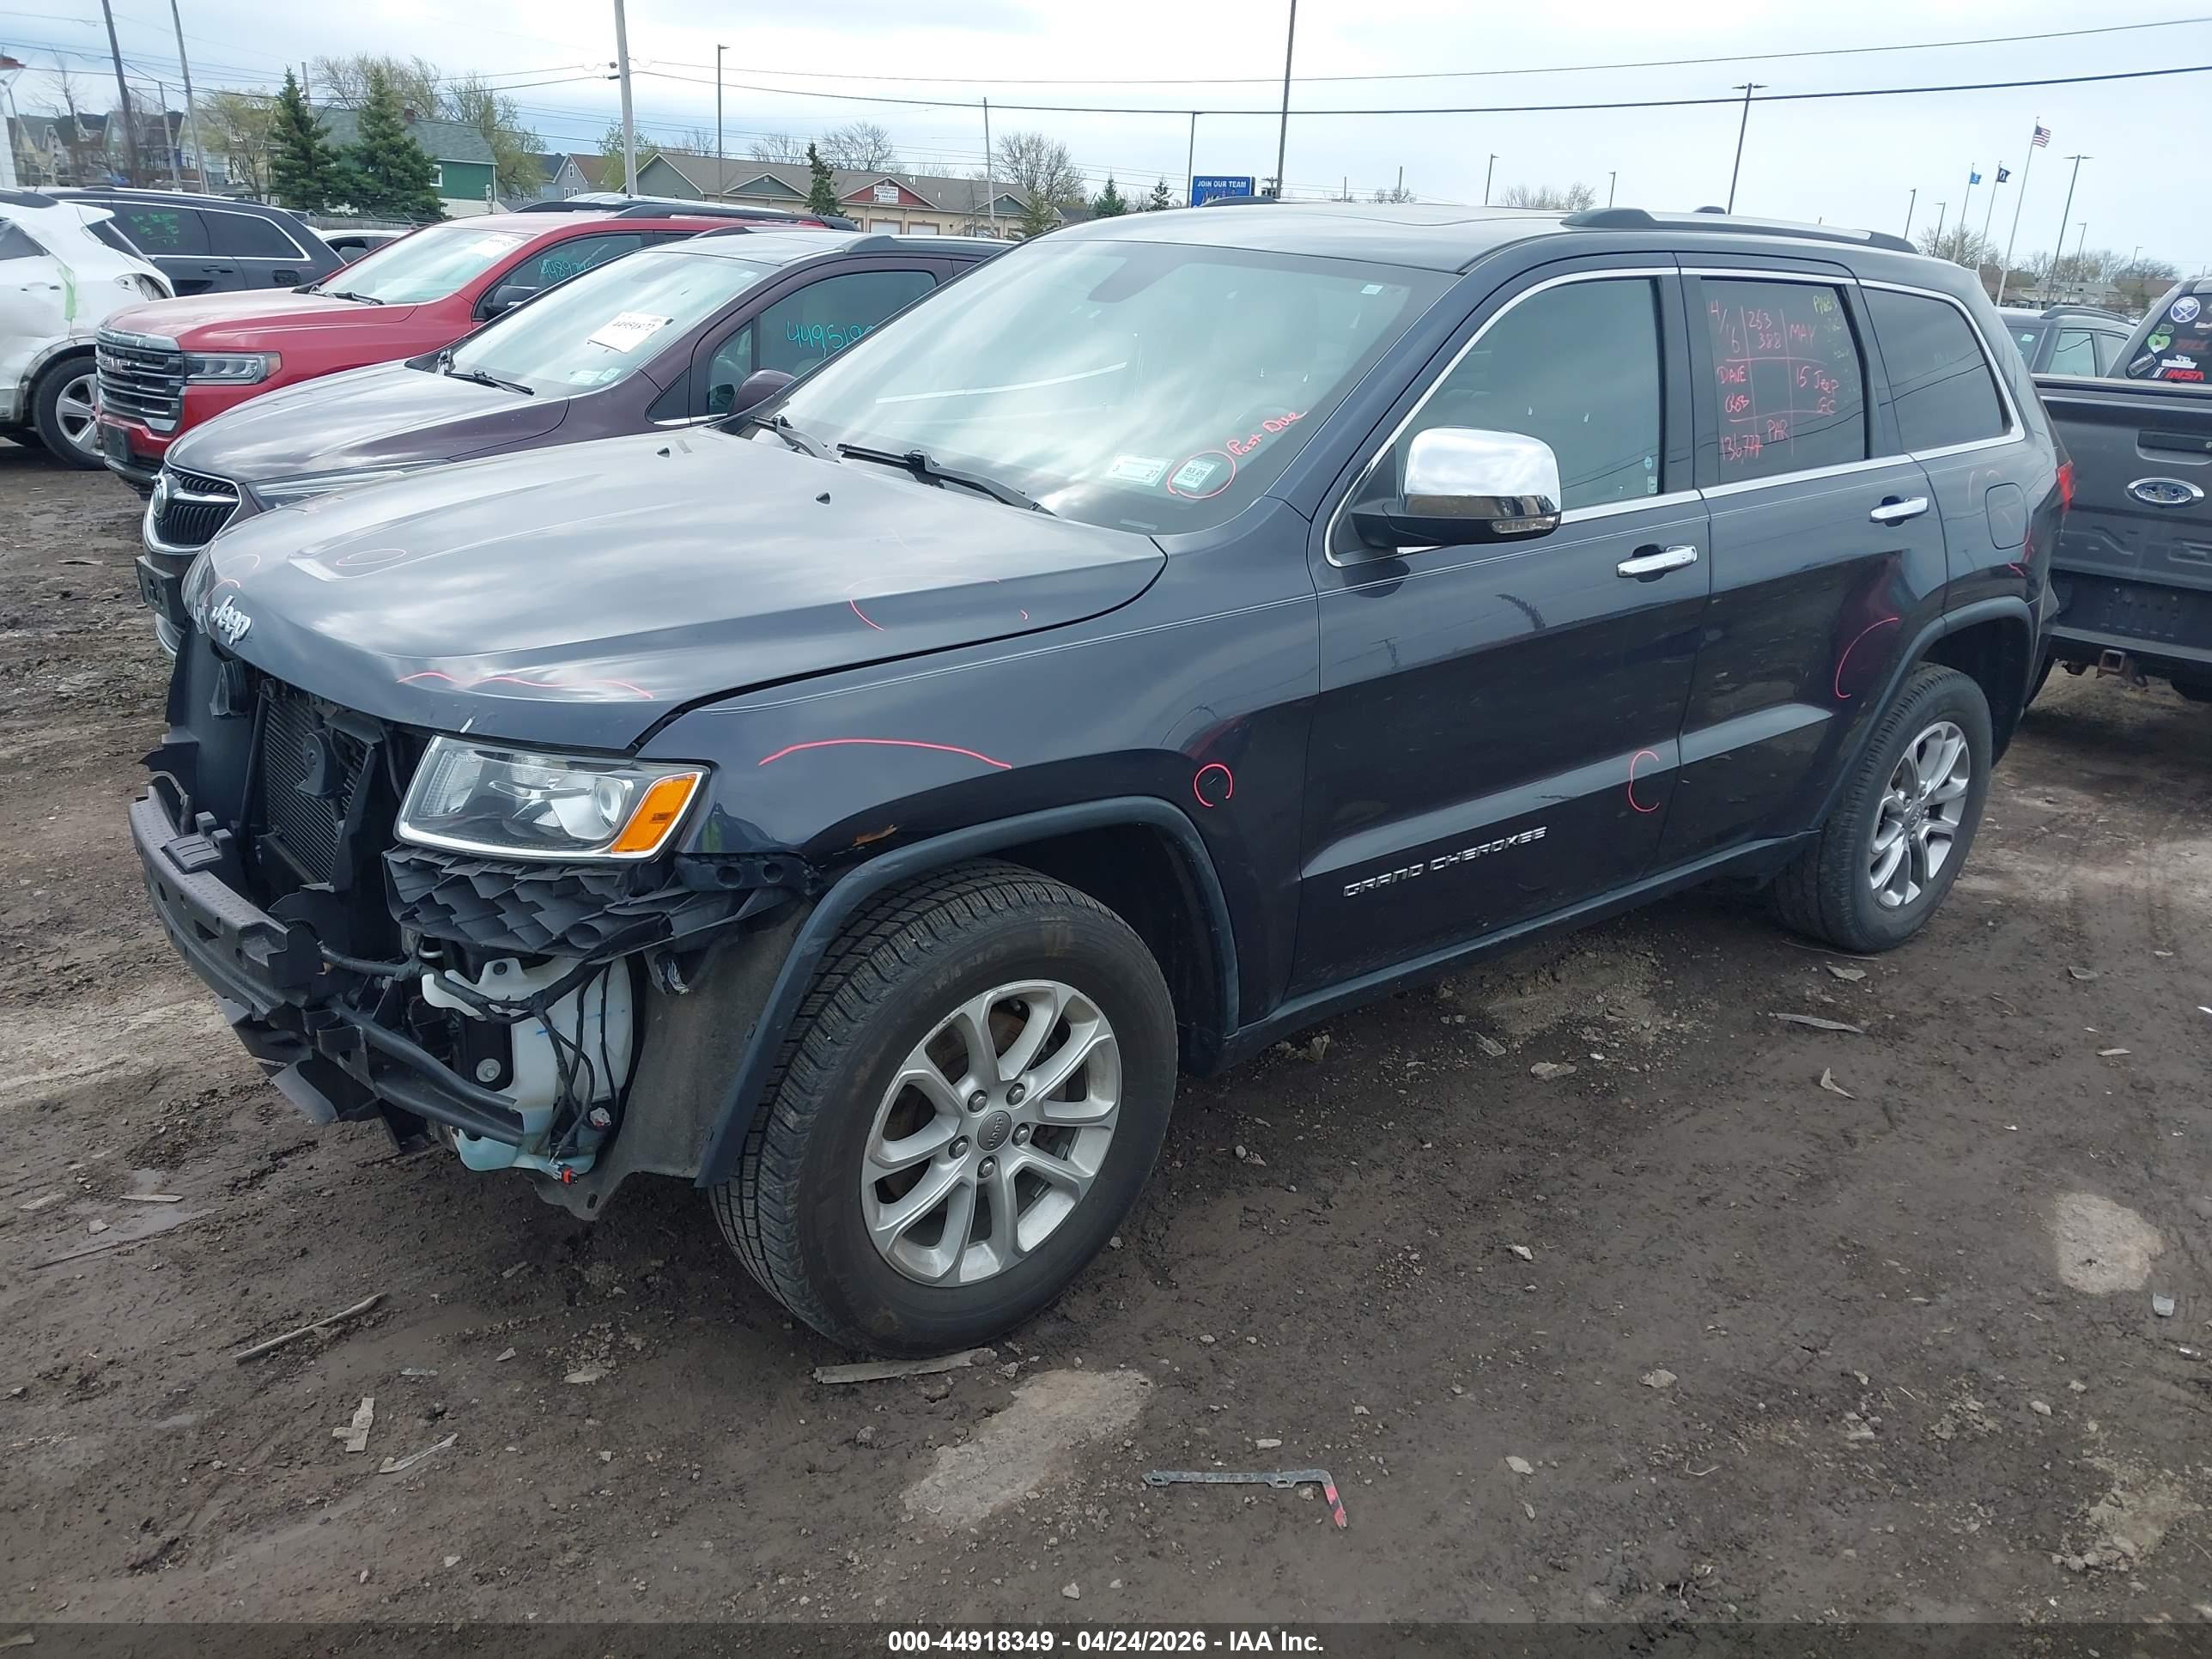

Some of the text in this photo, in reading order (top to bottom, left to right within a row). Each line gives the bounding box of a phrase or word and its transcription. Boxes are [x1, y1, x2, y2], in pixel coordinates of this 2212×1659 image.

[1213, 179, 1227, 188] OUR
[1748, 308, 1772, 330] 263
[1758, 331, 1782, 350] 388
[1790, 324, 1817, 349] MAY
[1226, 410, 1308, 456] Past Due
[209, 594, 252, 646] Jeep
[1343, 826, 1547, 897] GRAND CHEROKEE
